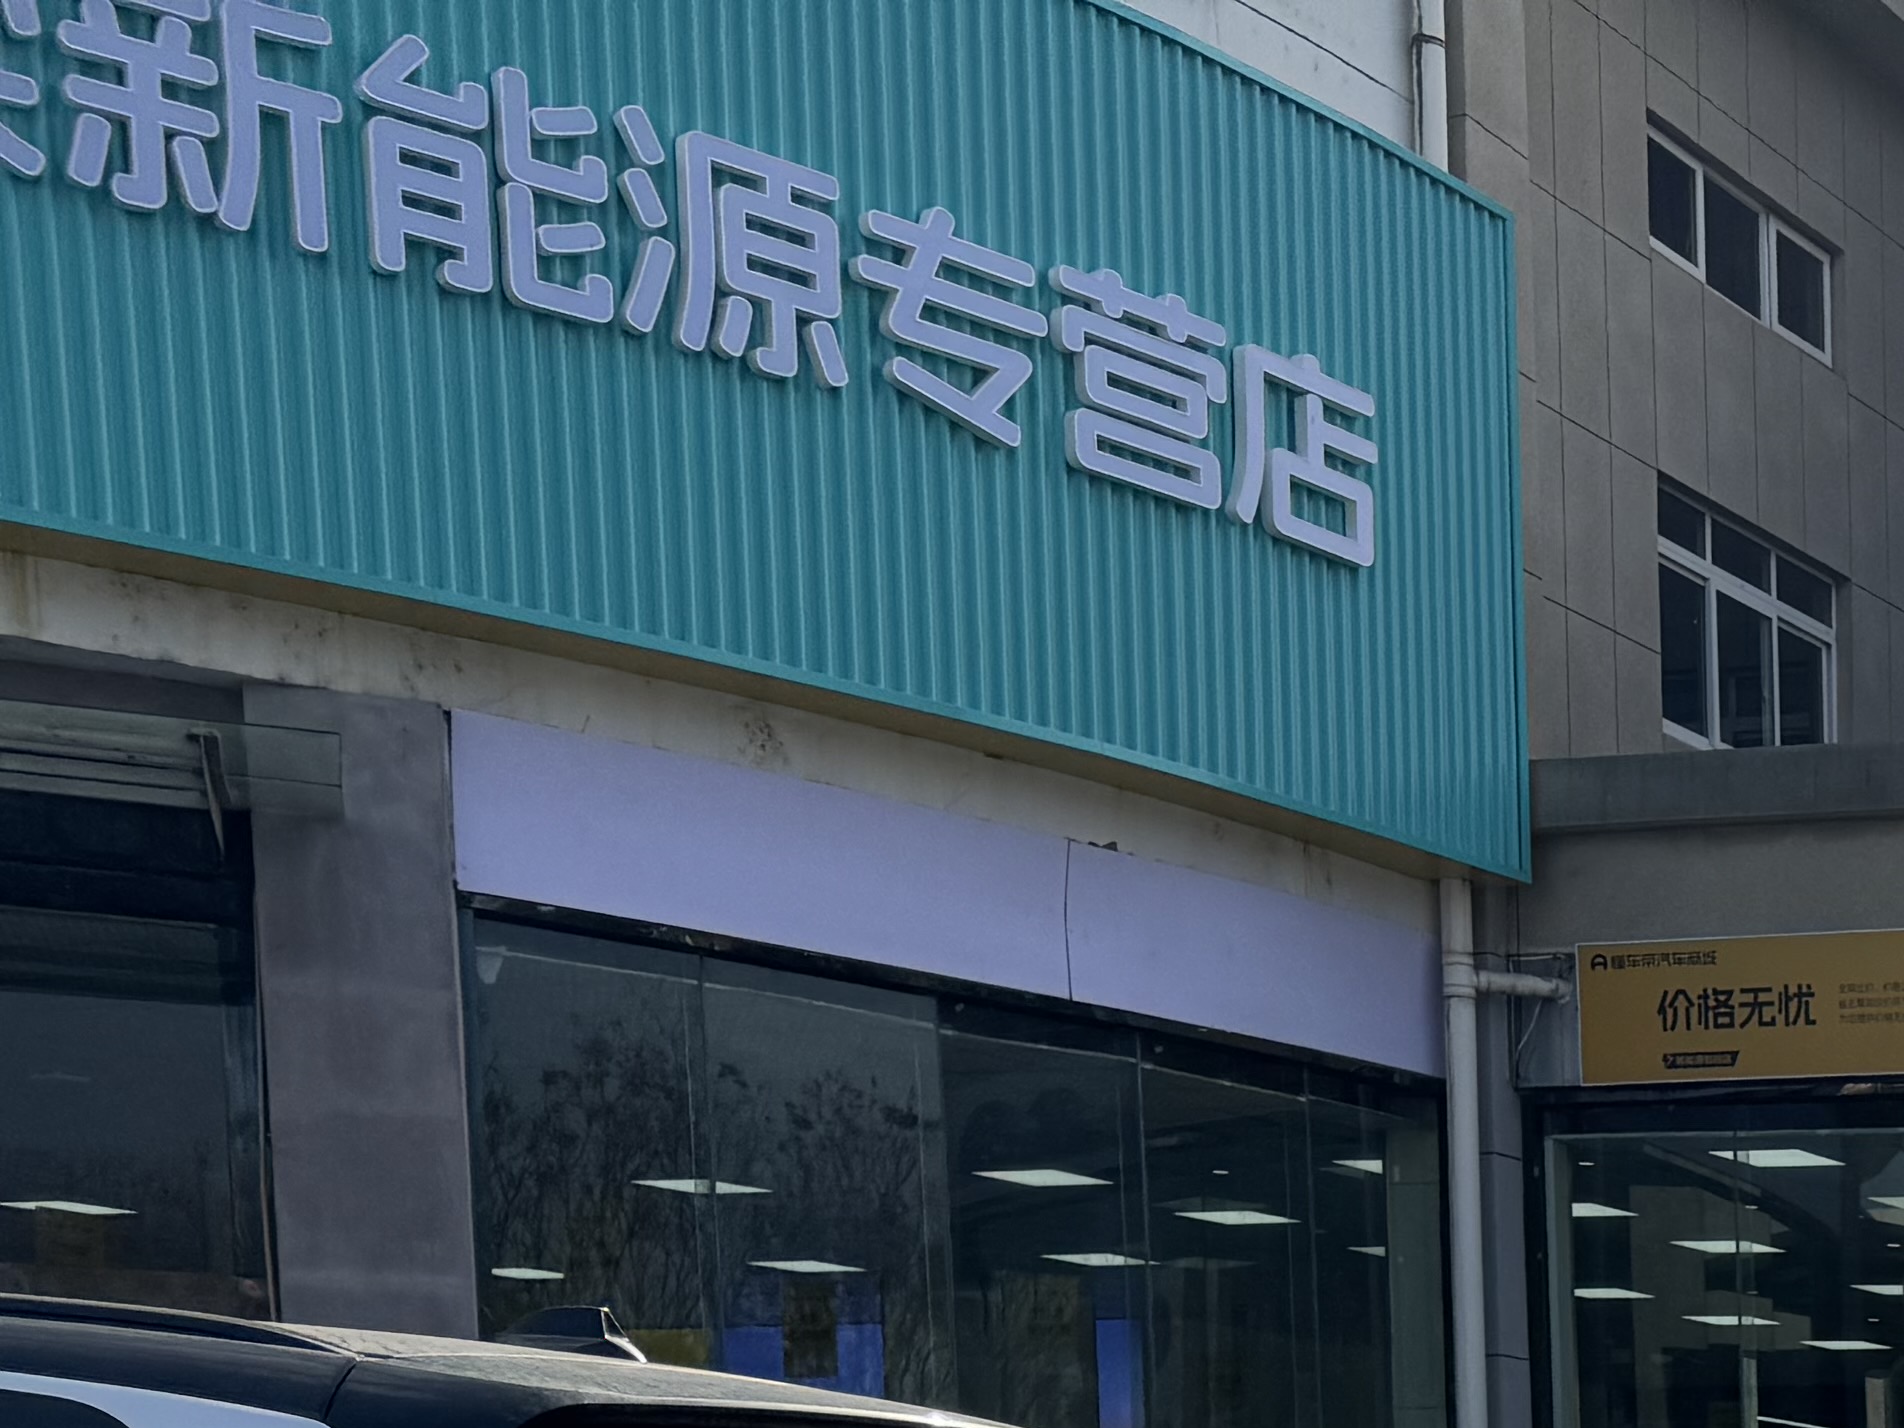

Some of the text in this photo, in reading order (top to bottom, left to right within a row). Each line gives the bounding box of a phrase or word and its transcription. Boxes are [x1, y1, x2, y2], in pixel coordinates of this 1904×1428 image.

[0, 0, 1376, 569] 新能源专营店
[1656, 983, 1817, 1033] 价格无忧
